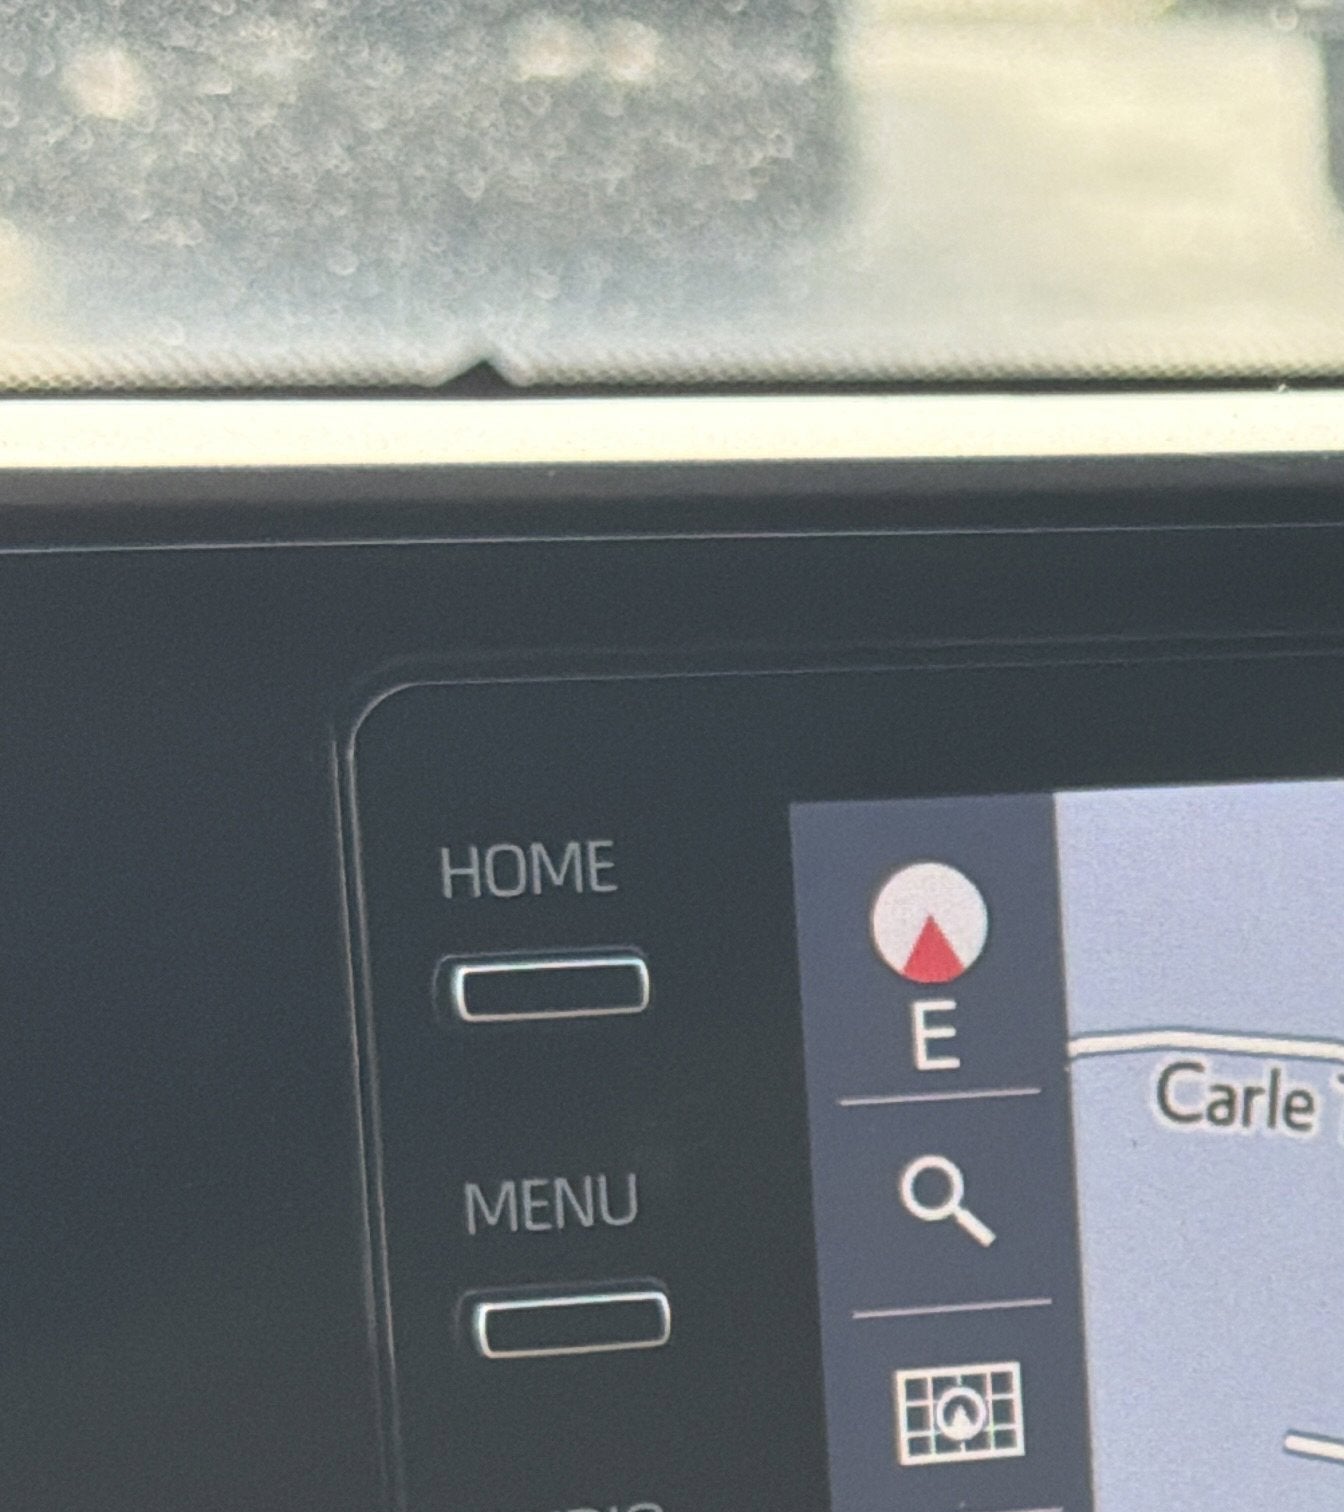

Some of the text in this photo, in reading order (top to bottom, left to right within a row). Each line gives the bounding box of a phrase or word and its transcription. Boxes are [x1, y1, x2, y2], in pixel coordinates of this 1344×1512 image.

[441, 840, 618, 898] HOME
[912, 1000, 961, 1070] E
[1157, 1061, 1316, 1134] Carle
[464, 1173, 638, 1235] MENU
